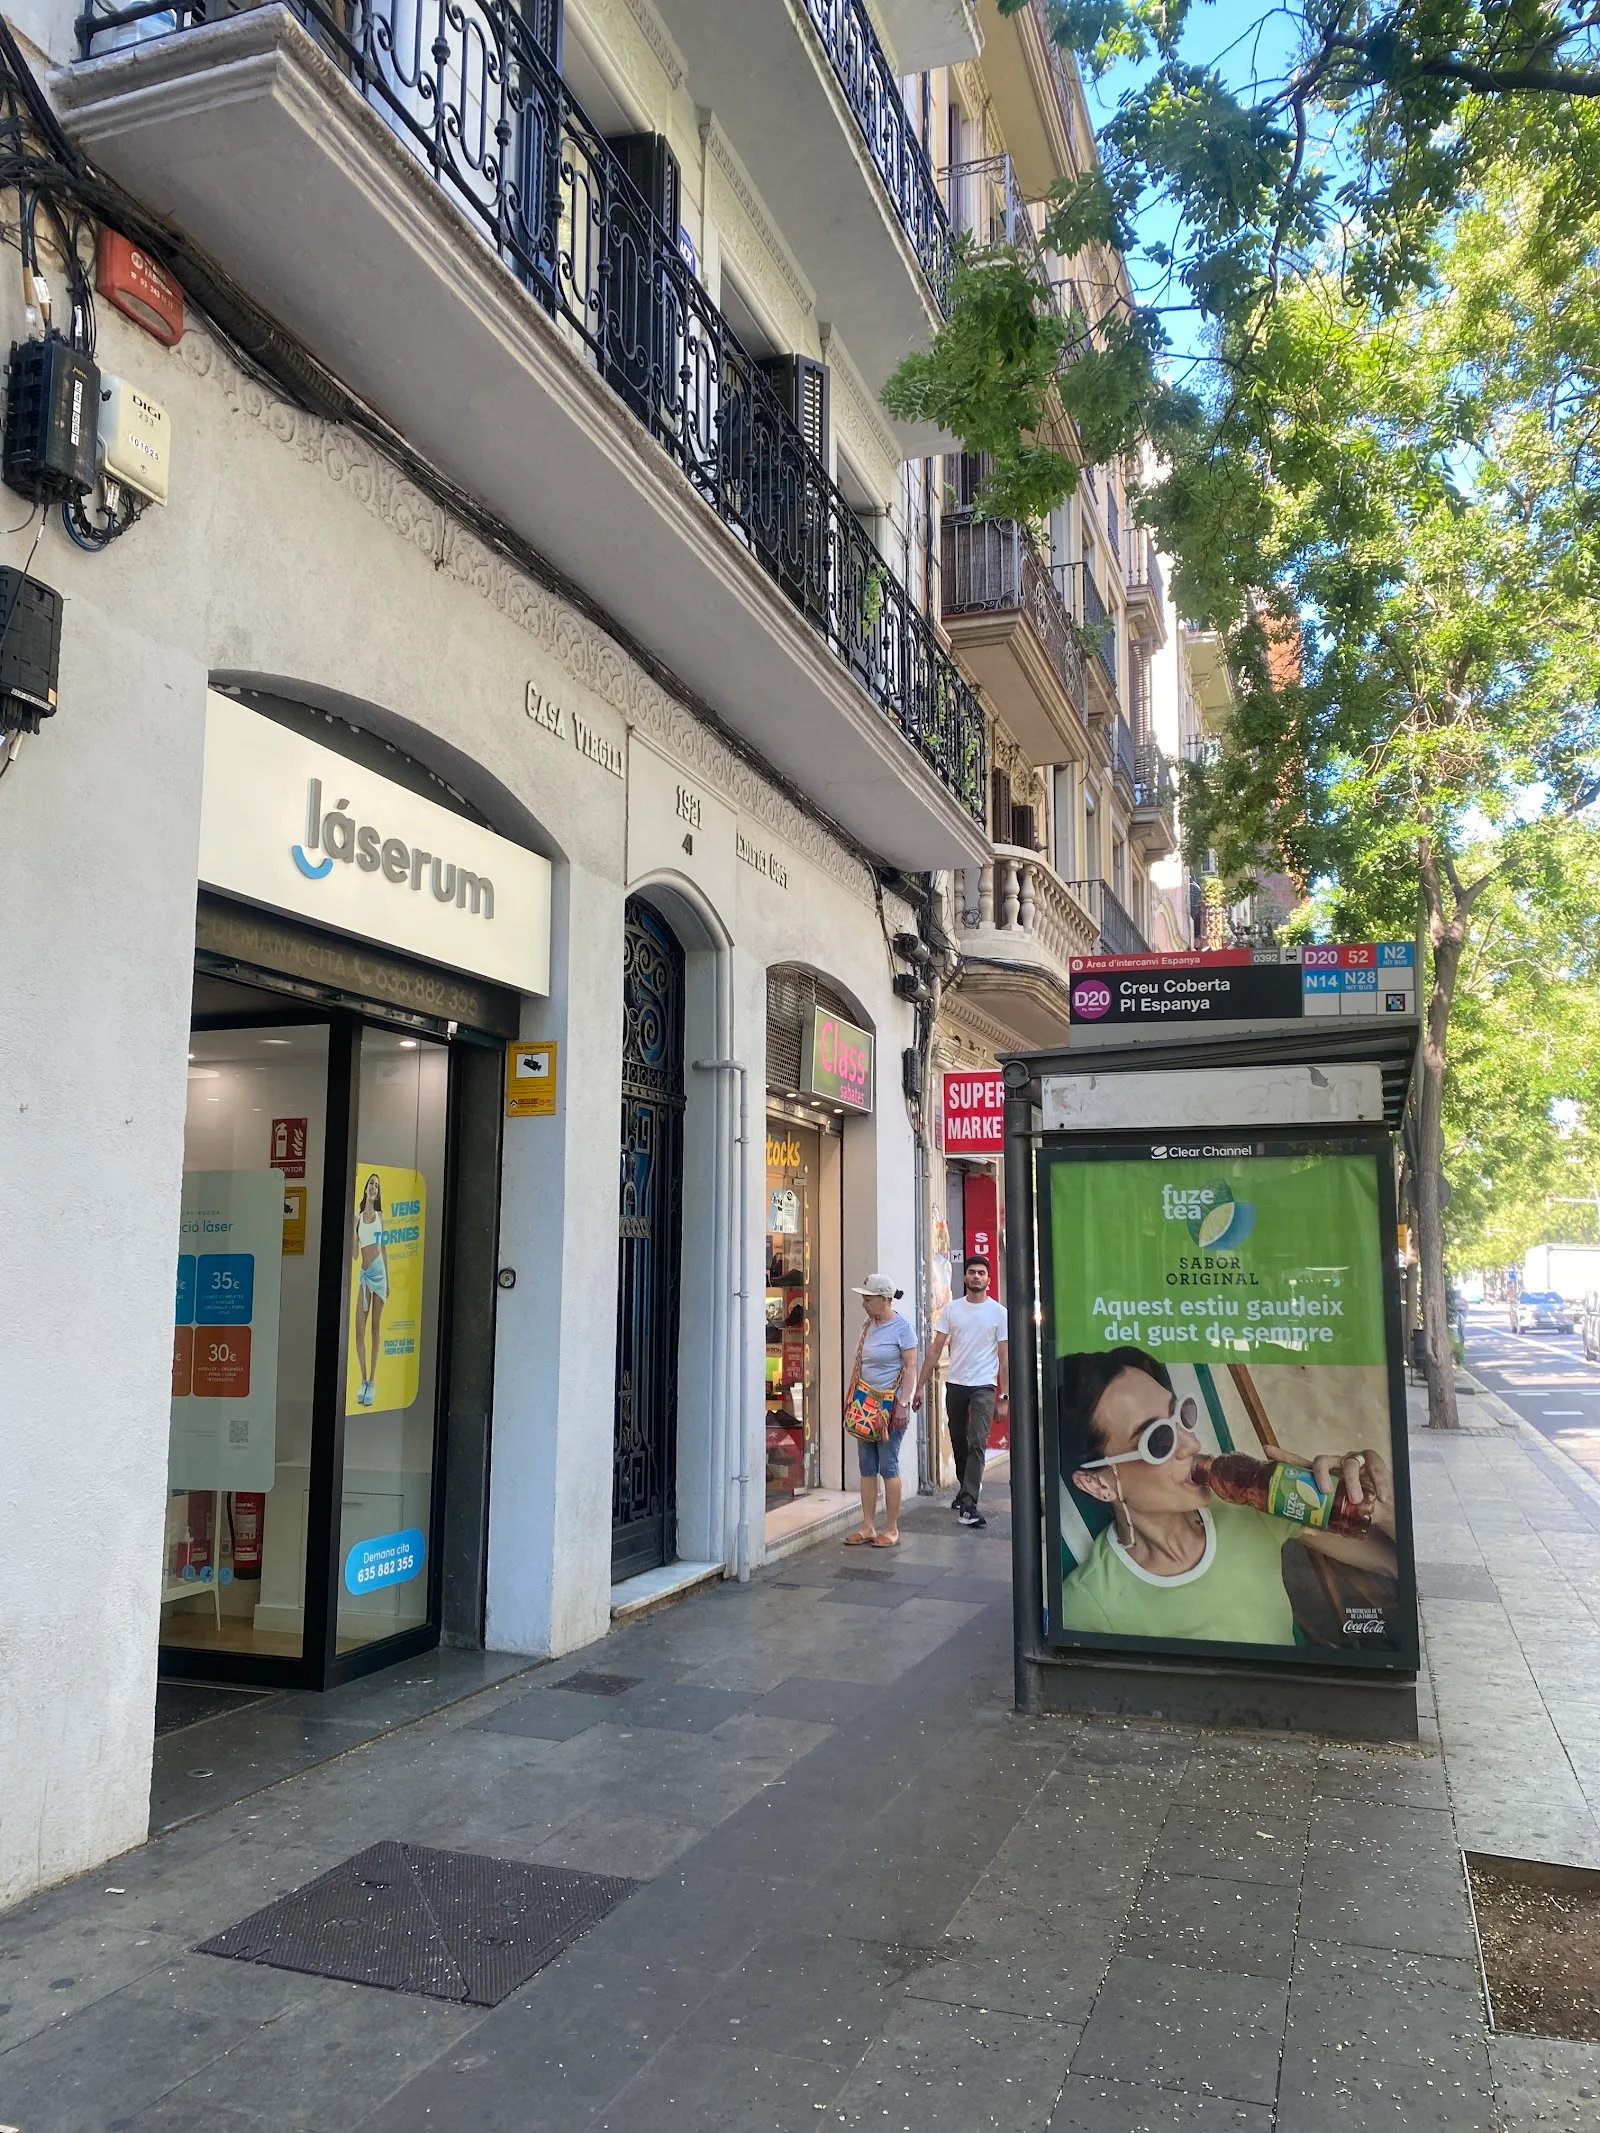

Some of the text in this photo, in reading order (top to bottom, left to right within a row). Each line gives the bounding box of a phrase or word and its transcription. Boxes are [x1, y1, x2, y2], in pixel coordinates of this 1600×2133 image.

[132, 394, 161, 420] DIGI
[138, 410, 154, 427] 233
[129, 434, 160, 461] 101025
[525, 680, 625, 780] CASA VIRGILI
[675, 785, 702, 830] 1921
[307, 777, 495, 920] láserum
[1086, 958, 1107, 969] Àrea
[1108, 957, 1159, 968] d'intercanvi
[1161, 955, 1201, 966] Espanya
[1253, 953, 1278, 963] 0392
[1304, 946, 1406, 965] D20 52 N2
[305, 945, 347, 977] CITA
[414, 976, 446, 1007] 882
[449, 985, 480, 1017] 355
[1119, 978, 1231, 995] Creu Coberta
[1306, 971, 1376, 989] N14 N28
[1074, 991, 1110, 1007] D20
[1120, 997, 1211, 1014] Pl Espanya
[821, 1020, 866, 1086] Class
[840, 1081, 865, 1107] sabates
[948, 1081, 1006, 1110] SUPER
[947, 1116, 1004, 1140] MARKE
[766, 1131, 801, 1167] tocks
[1169, 1145, 1252, 1158] Clear Channel
[279, 1165, 304, 1174] TINTOR
[1161, 1183, 1216, 1205] fuze
[391, 1199, 421, 1219] VENS
[1162, 1203, 1202, 1220] tea
[202, 1220, 234, 1233] làser
[373, 1225, 420, 1247] TORNES
[1179, 1257, 1241, 1270] SABOR
[1166, 1272, 1259, 1286] ORIGINAL
[1092, 1294, 1344, 1322] Aquest estiu gaudeix
[1104, 1321, 1334, 1349] del gust de sempre
[1283, 1491, 1298, 1518] fuze
[1294, 1502, 1306, 1520] tea
[363, 1543, 410, 1565] Demana cita
[357, 1554, 414, 1583] 635 882 355
[1342, 1619, 1386, 1634] Coca-Cola
